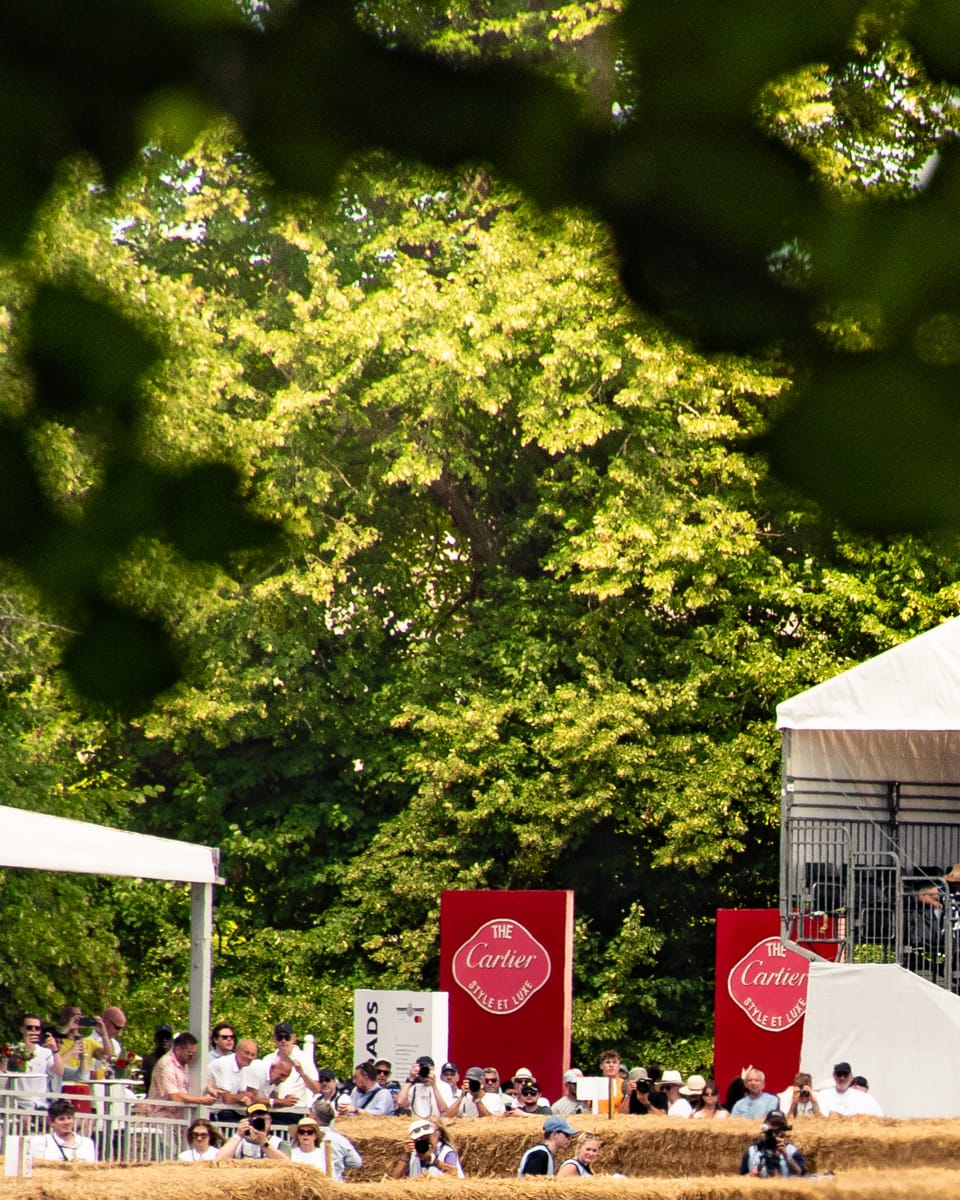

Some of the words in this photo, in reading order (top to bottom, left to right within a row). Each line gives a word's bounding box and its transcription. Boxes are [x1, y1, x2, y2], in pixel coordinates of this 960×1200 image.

[491, 925, 514, 939] THE
[465, 942, 537, 969] Cartier
[765, 942, 787, 957] THE
[741, 960, 809, 986] Cartier
[468, 980, 495, 1008] STYLE
[497, 999, 509, 1010] ET
[512, 980, 533, 1006] LUXE
[743, 997, 769, 1025] STYLE
[771, 1016, 782, 1027] ET
[785, 997, 807, 1023] LUXE
